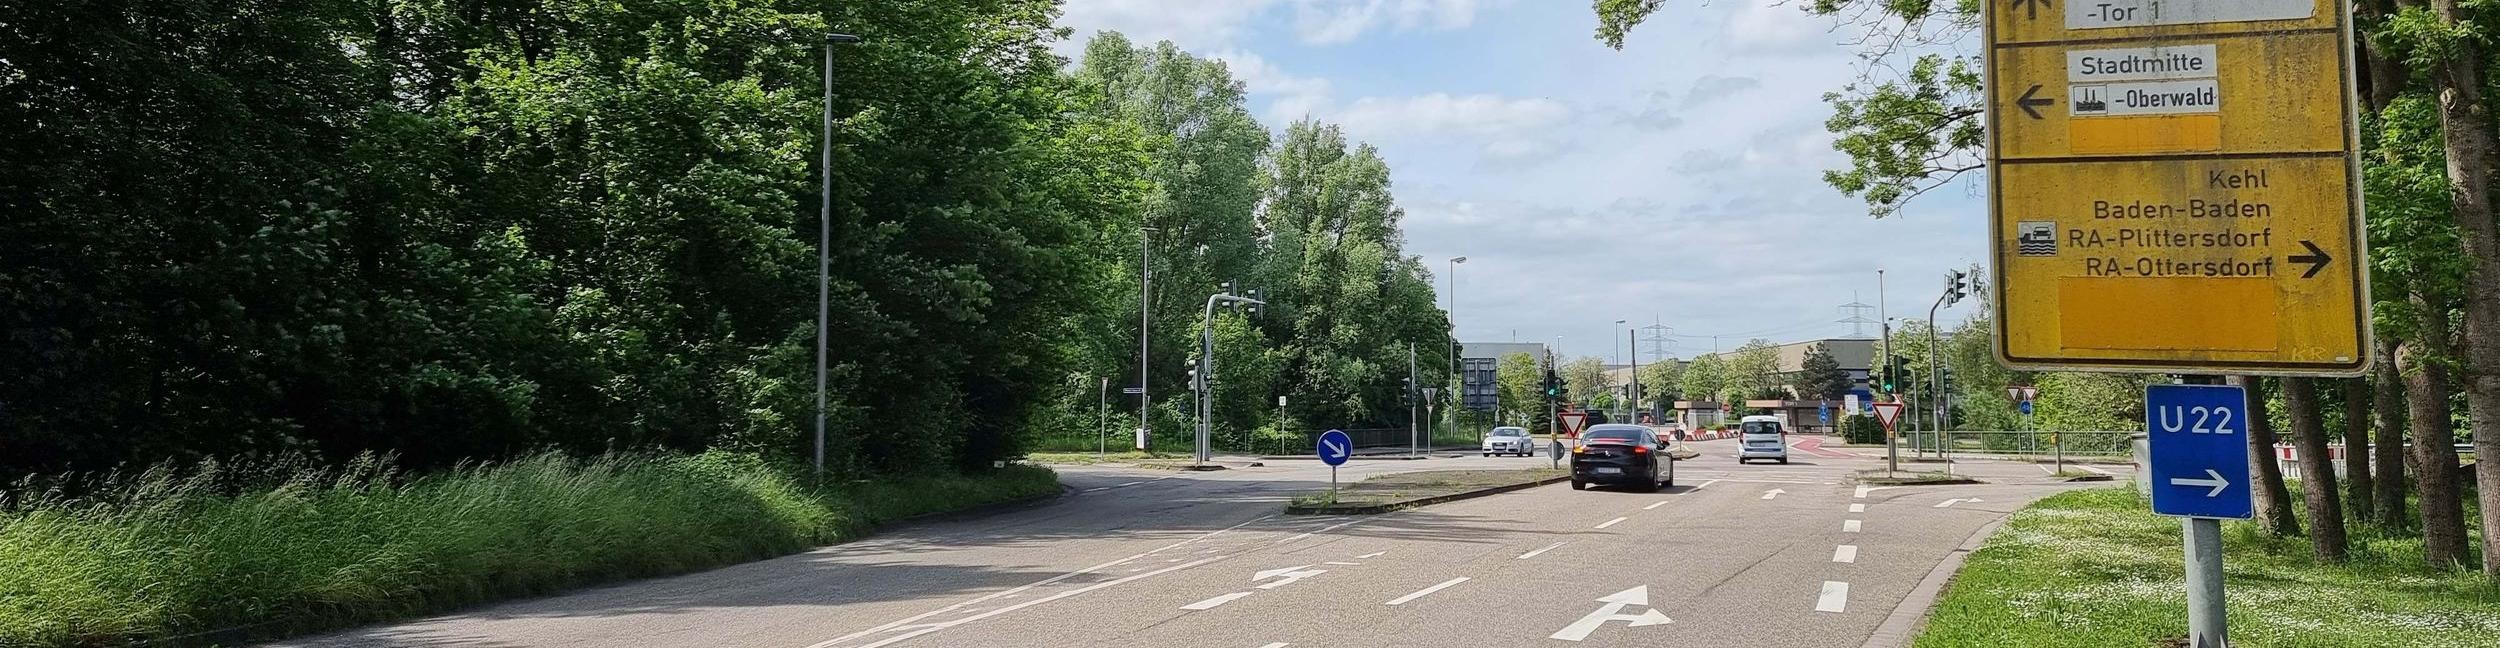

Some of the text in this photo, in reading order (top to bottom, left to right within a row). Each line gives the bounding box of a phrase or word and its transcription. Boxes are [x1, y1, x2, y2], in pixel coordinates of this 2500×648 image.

[2087, 1, 2159, 22] -Tor 1
[2081, 55, 2203, 75] Stadtmitte
[2115, 87, 2214, 108] -Oberwald
[2209, 169, 2268, 189] Kehl
[2094, 199, 2270, 219] Baden-Baden
[2069, 227, 2271, 248] RA-Plittersdorf
[2086, 256, 2273, 276] RA-Ottersdorf
